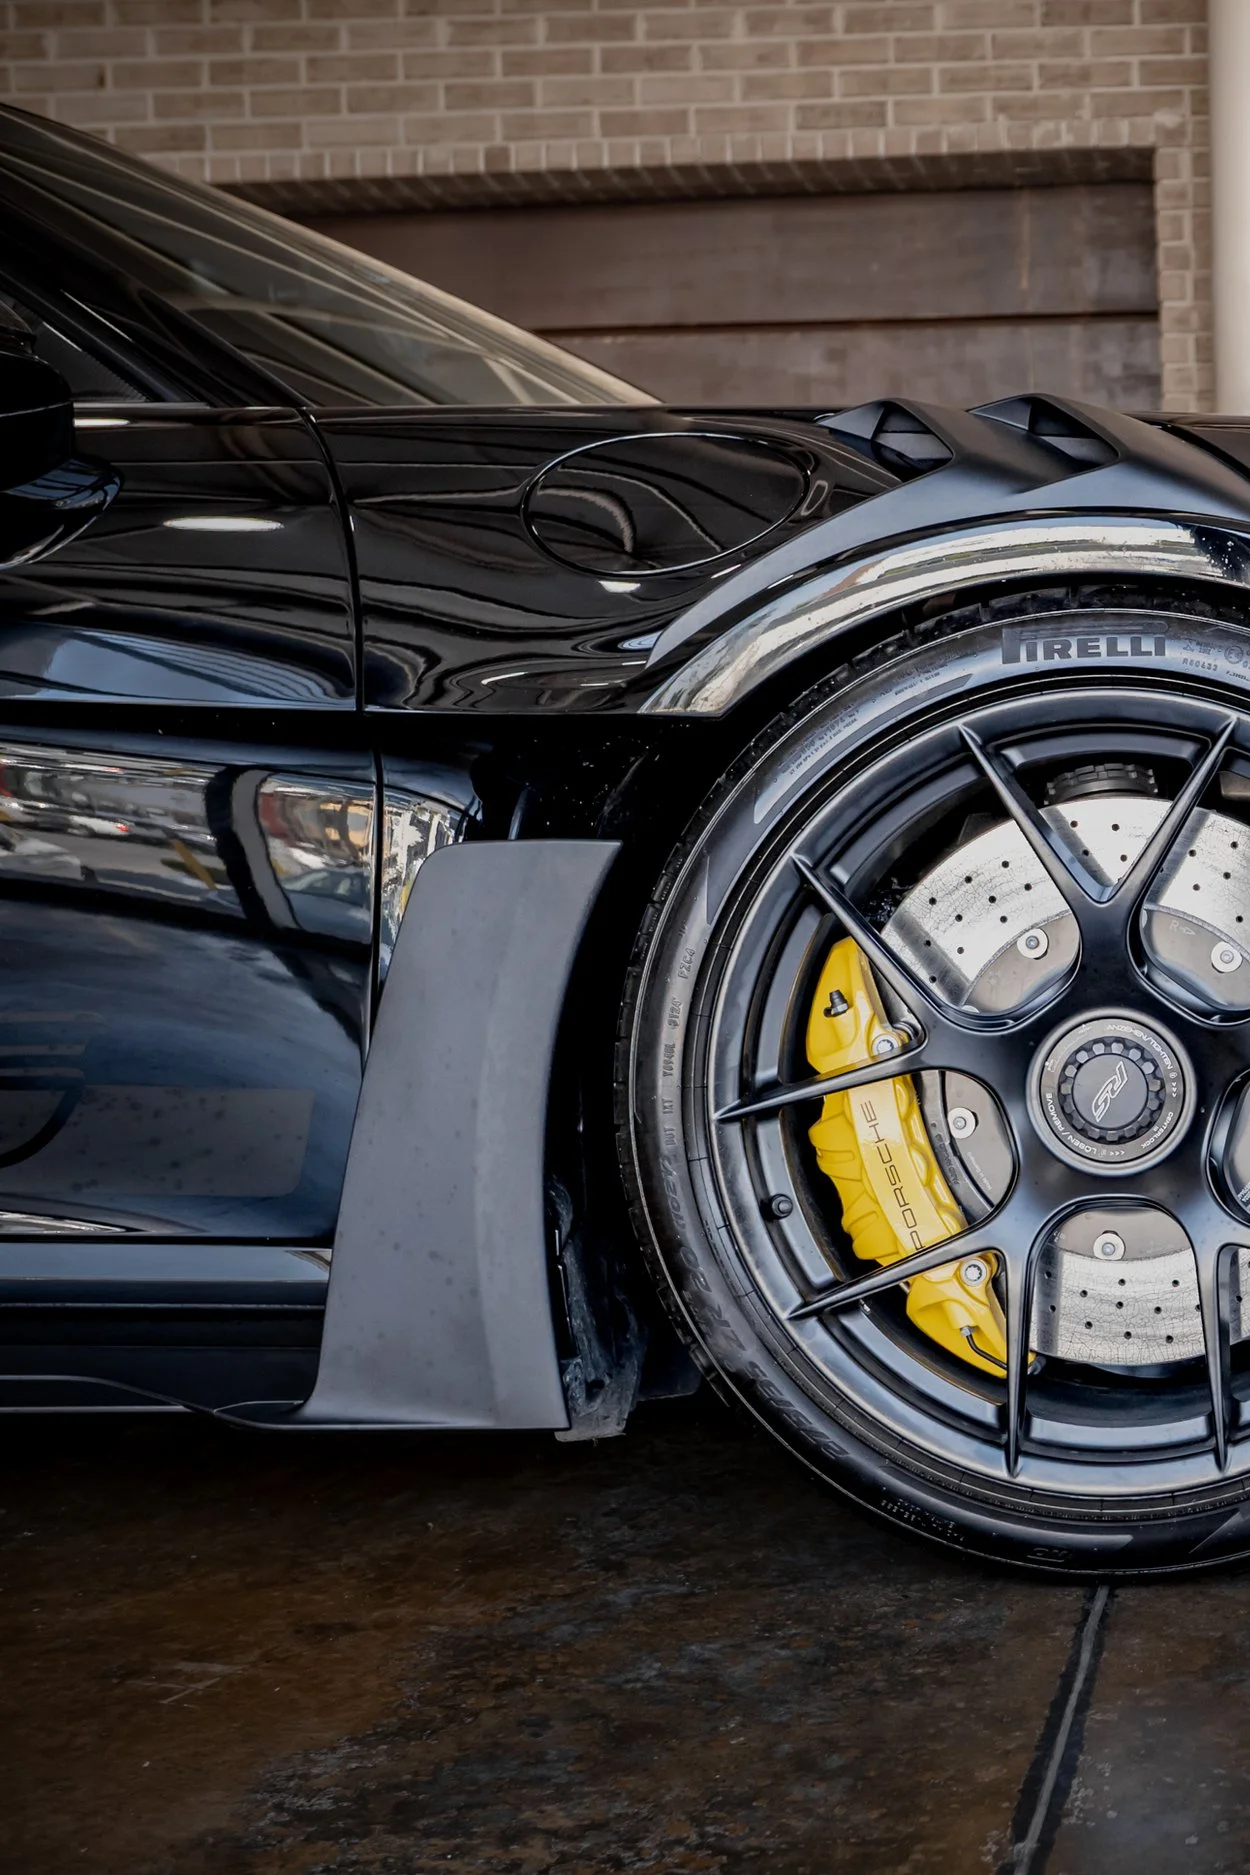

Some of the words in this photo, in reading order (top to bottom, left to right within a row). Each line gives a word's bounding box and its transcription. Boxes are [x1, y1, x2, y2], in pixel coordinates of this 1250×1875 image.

[1001, 620, 1168, 664] PIRELLI
[1045, 1091, 1065, 1132] REMOVE
[1139, 1110, 1174, 1149] CENTERLOCK
[860, 1100, 925, 1251] PORSCHE
